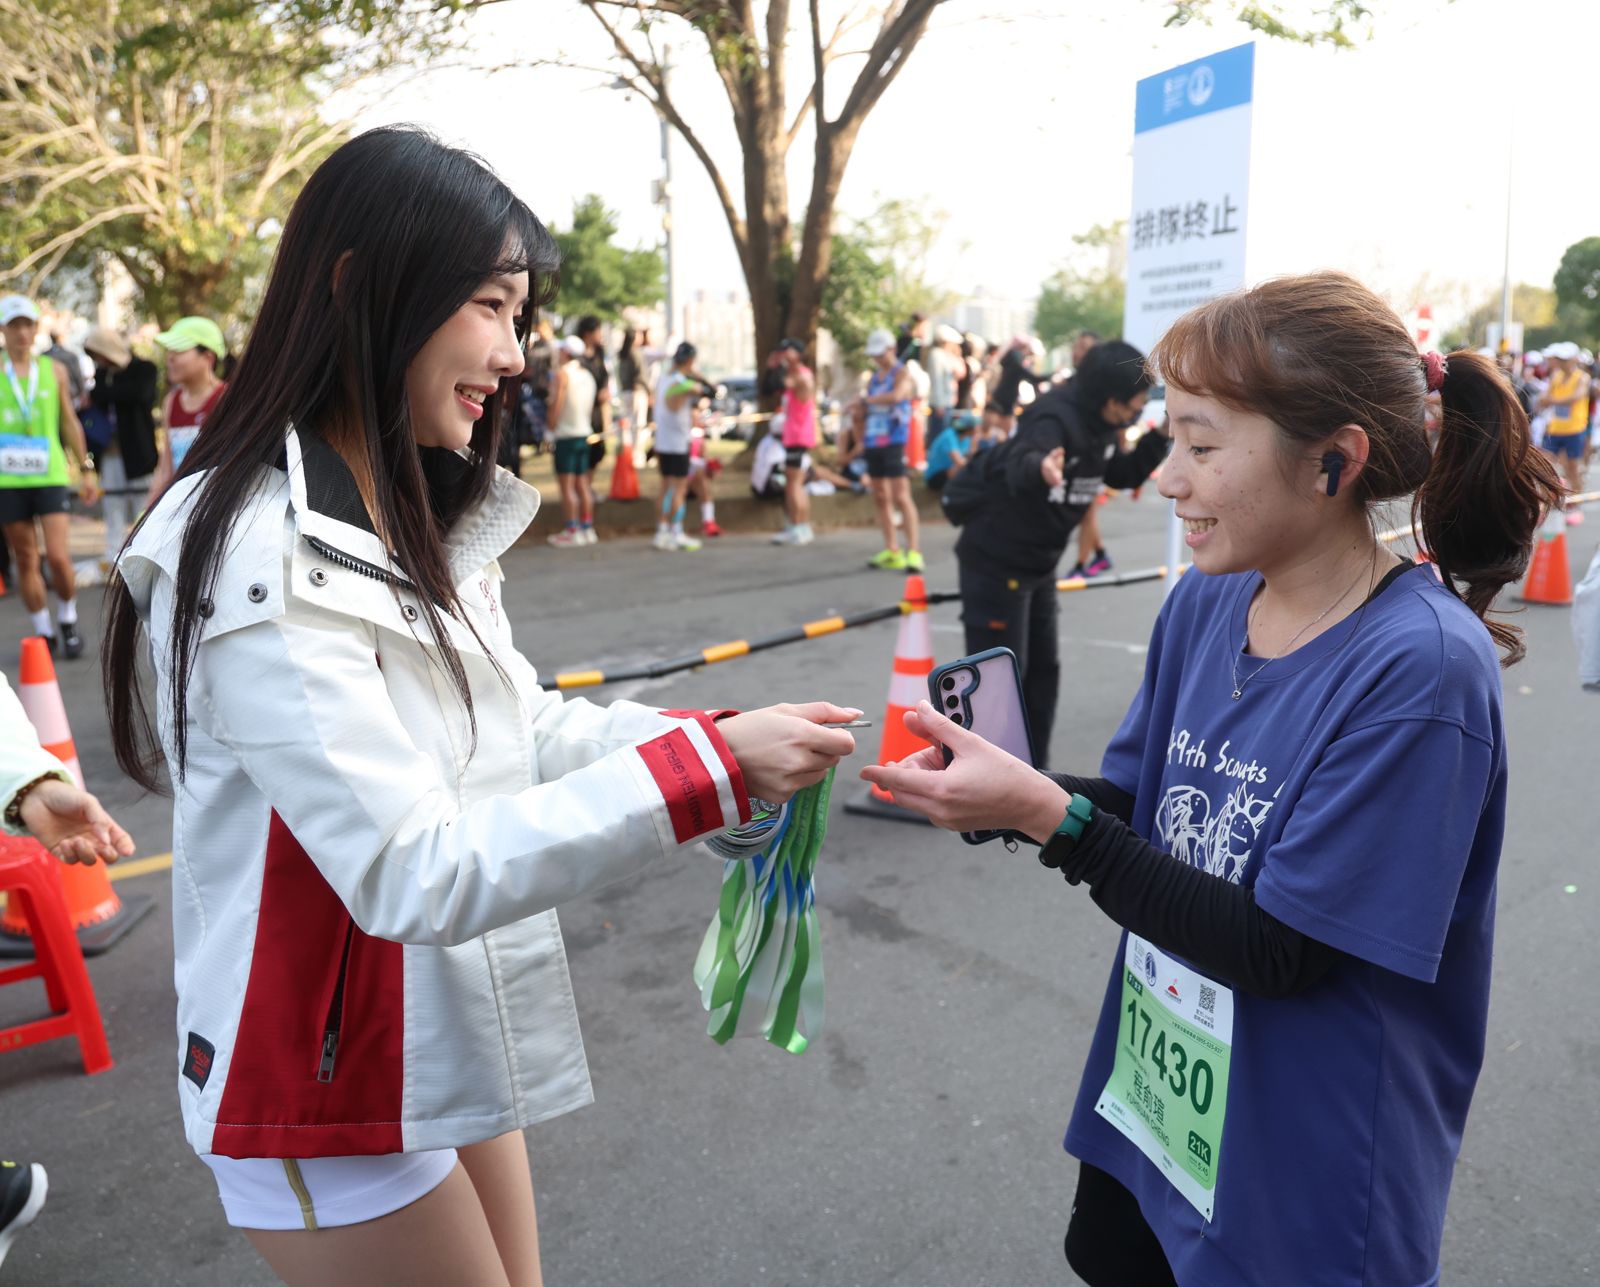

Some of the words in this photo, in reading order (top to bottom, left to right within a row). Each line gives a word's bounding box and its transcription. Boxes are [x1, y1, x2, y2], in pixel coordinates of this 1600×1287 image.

[1133, 193, 1237, 250] 排隊終止
[660, 741, 686, 775] GIRLS
[1214, 740, 1267, 784] Scouts
[1128, 998, 1214, 1115] 17430
[1189, 1135, 1209, 1162] 21K
